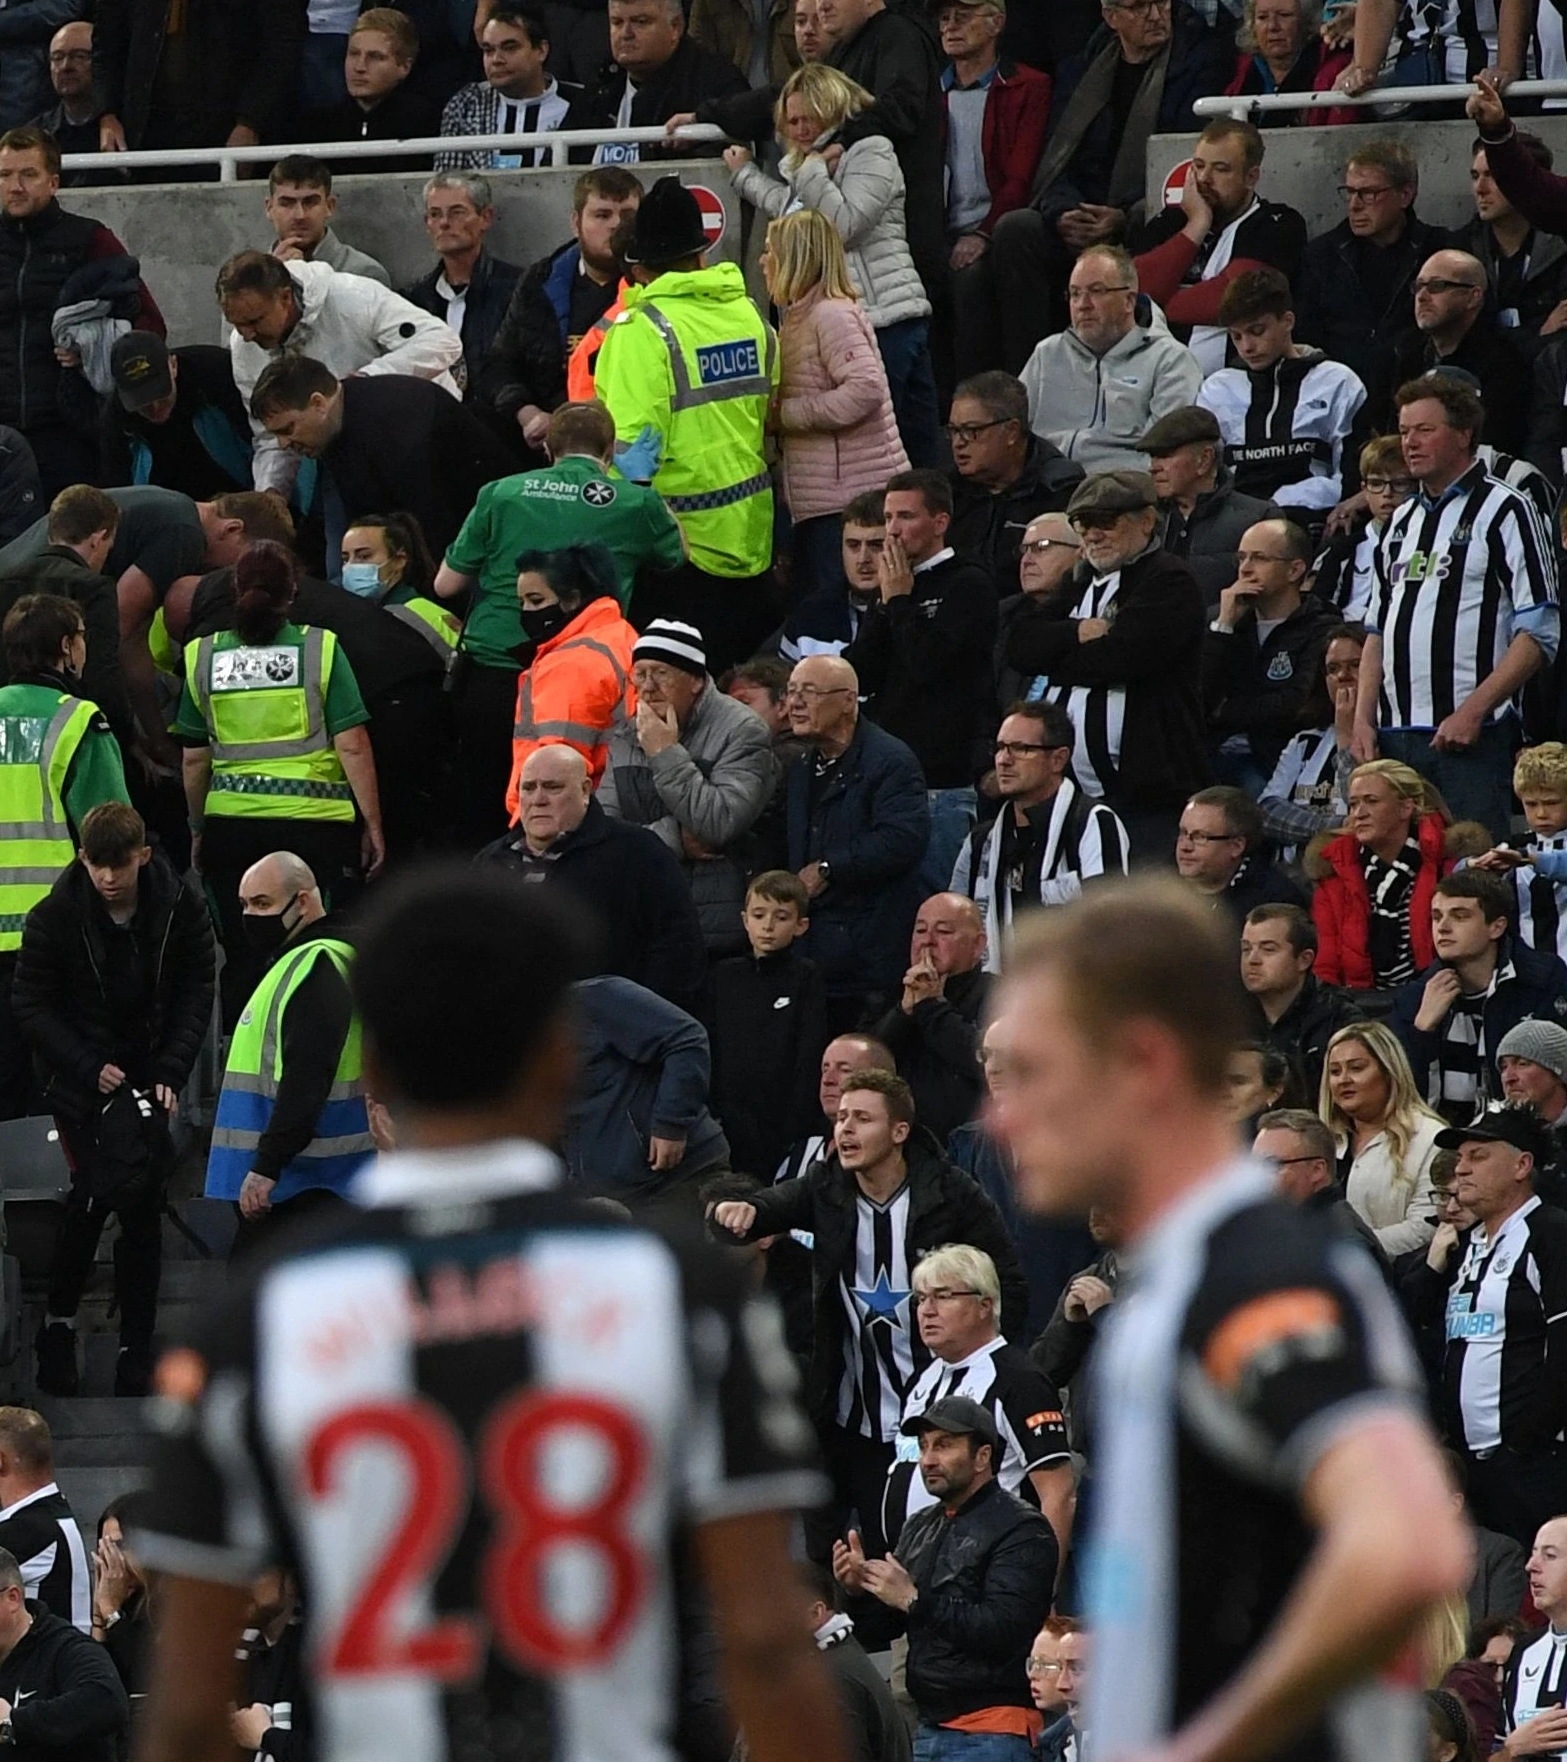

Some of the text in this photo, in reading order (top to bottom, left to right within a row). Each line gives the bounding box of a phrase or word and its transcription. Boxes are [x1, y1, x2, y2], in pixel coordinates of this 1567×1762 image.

[697, 346, 759, 379] POLICE
[1245, 446, 1286, 462] NORTH
[521, 489, 578, 502] Ambulance
[524, 478, 580, 495] St John
[1391, 552, 1452, 585] ntl:
[300, 1391, 652, 1684] 28
